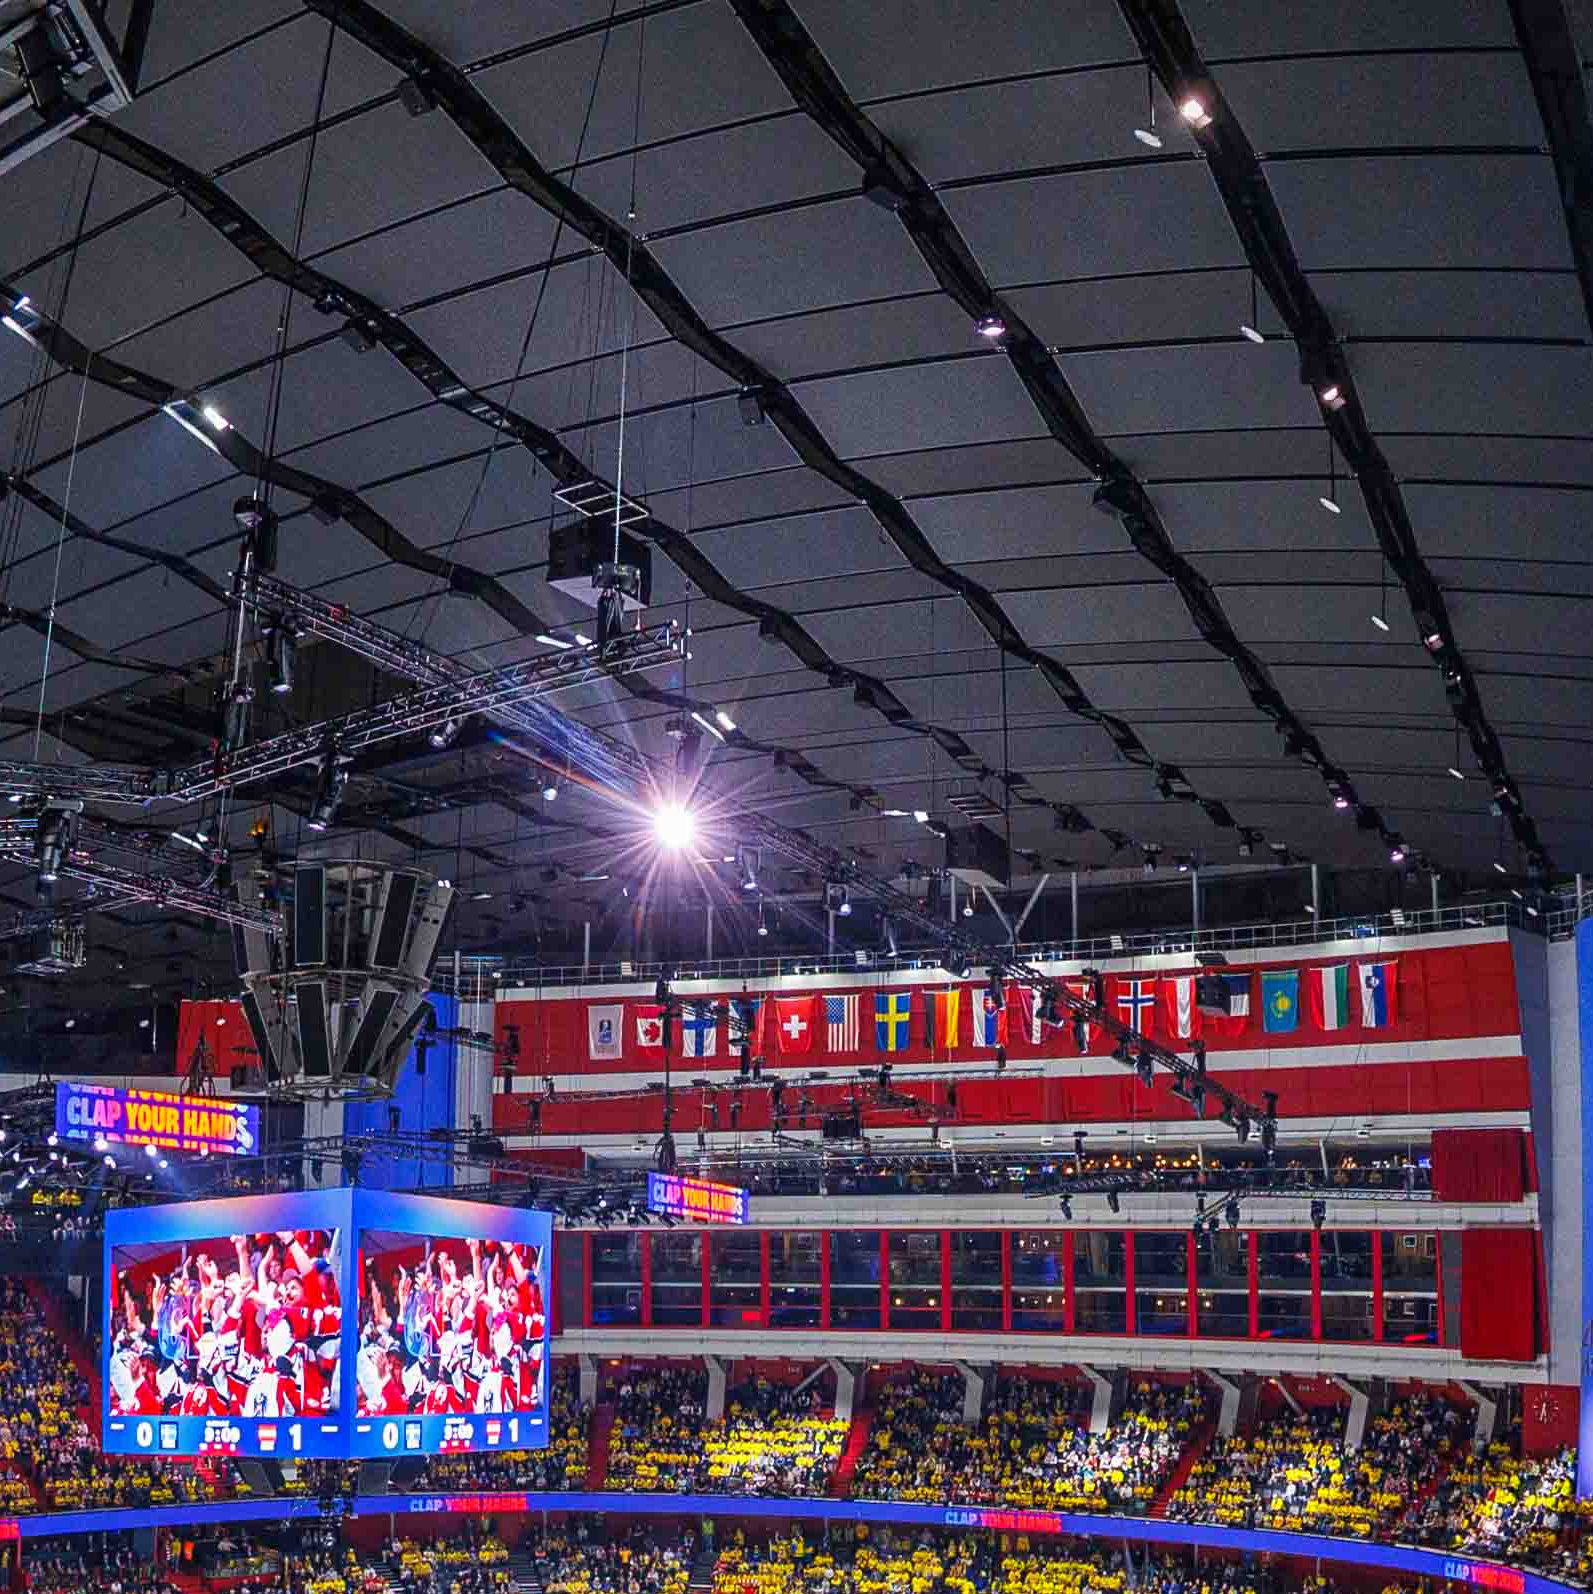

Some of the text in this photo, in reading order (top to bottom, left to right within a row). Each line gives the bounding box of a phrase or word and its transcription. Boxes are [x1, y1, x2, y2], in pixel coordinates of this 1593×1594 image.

[67, 1096, 121, 1128] CLAP
[125, 1103, 180, 1134] YOUR
[183, 1109, 253, 1148] HANDS
[653, 1182, 681, 1204] CLAP
[682, 1186, 710, 1209] YOUR
[136, 1422, 153, 1448] 0
[288, 1424, 302, 1450] 1
[382, 1422, 399, 1449] 0
[508, 1418, 519, 1443] 1
